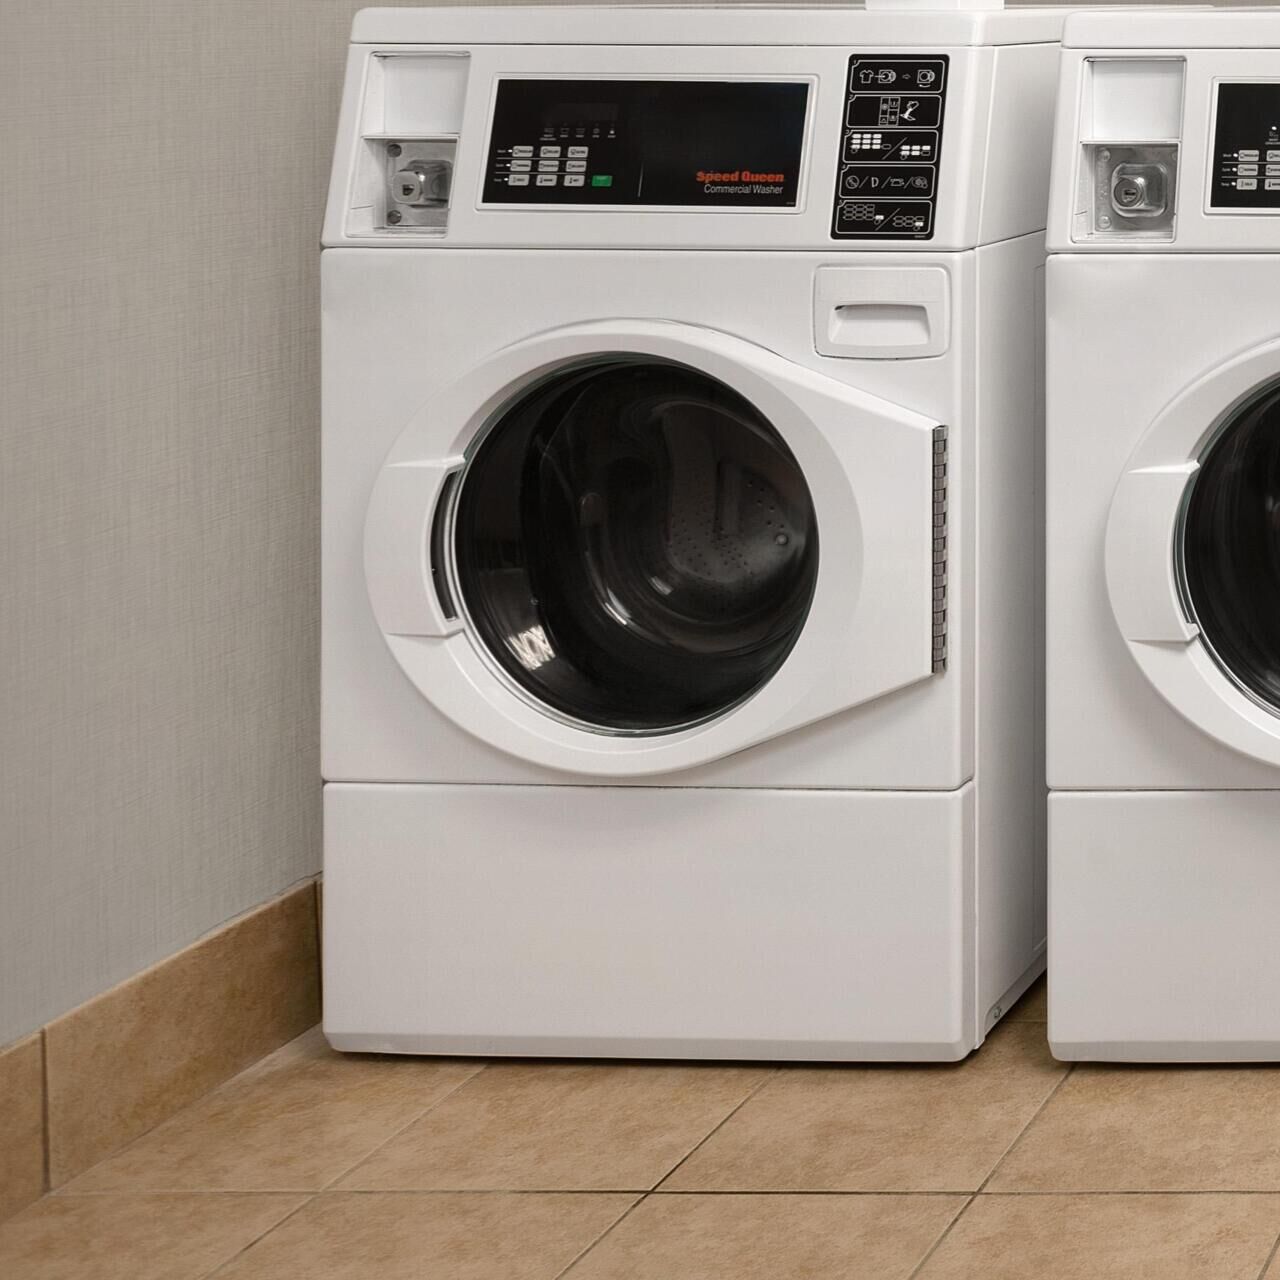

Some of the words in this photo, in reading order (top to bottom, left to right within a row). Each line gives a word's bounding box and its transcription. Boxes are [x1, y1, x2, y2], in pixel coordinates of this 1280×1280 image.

[696, 171, 740, 183] Speed
[741, 171, 785, 182] Queen
[704, 184, 751, 194] Commercial
[753, 184, 784, 194] Washer
